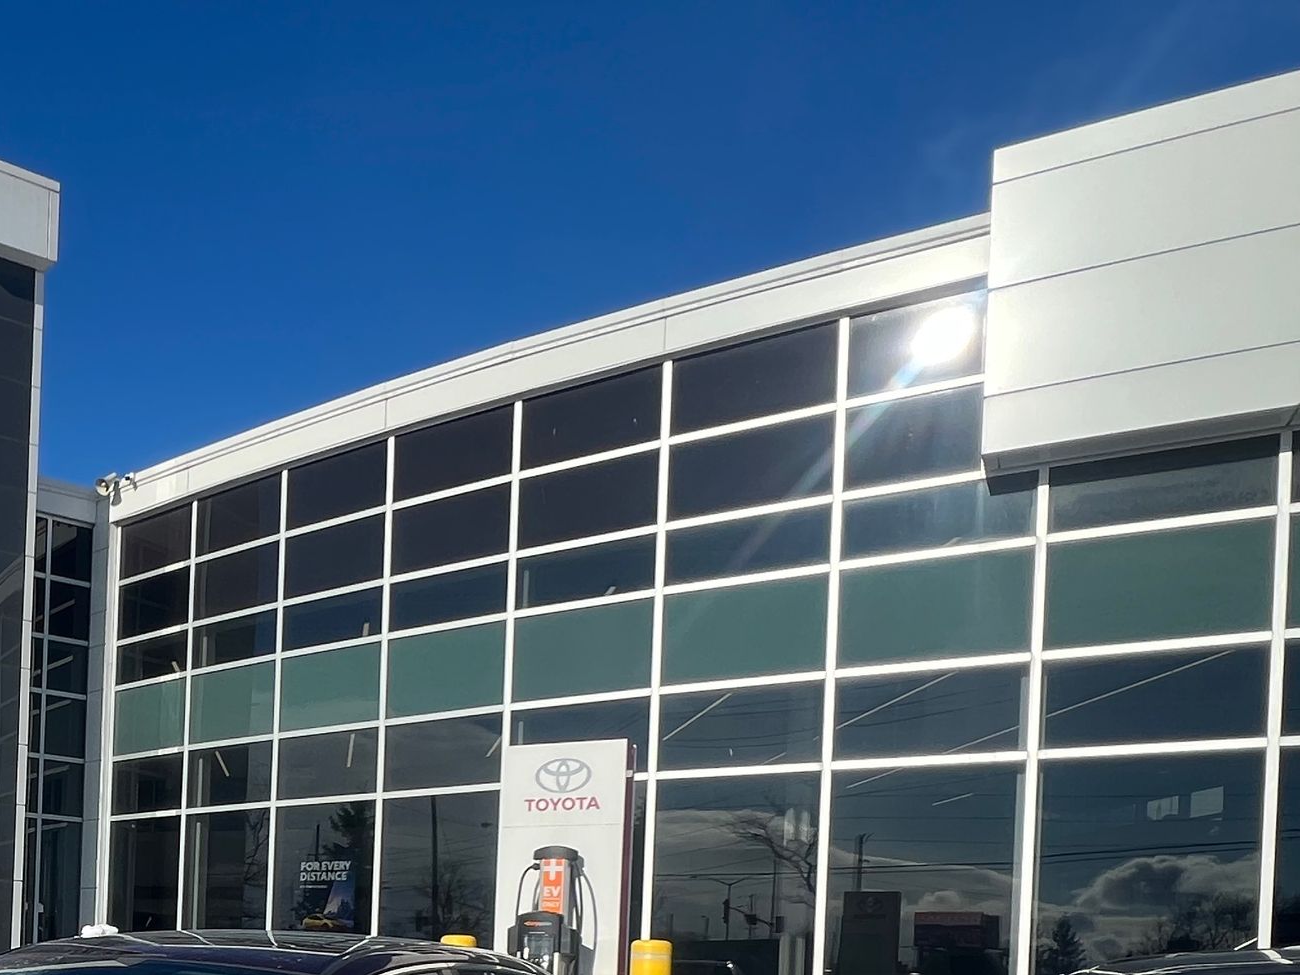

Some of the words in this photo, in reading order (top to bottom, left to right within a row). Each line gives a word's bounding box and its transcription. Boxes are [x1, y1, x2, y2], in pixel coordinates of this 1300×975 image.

[524, 797, 600, 812] TOYOTA
[300, 861, 320, 871] FOR
[321, 861, 351, 871] EVERY
[300, 871, 348, 881] DISTANCE
[543, 886, 561, 897] EV
